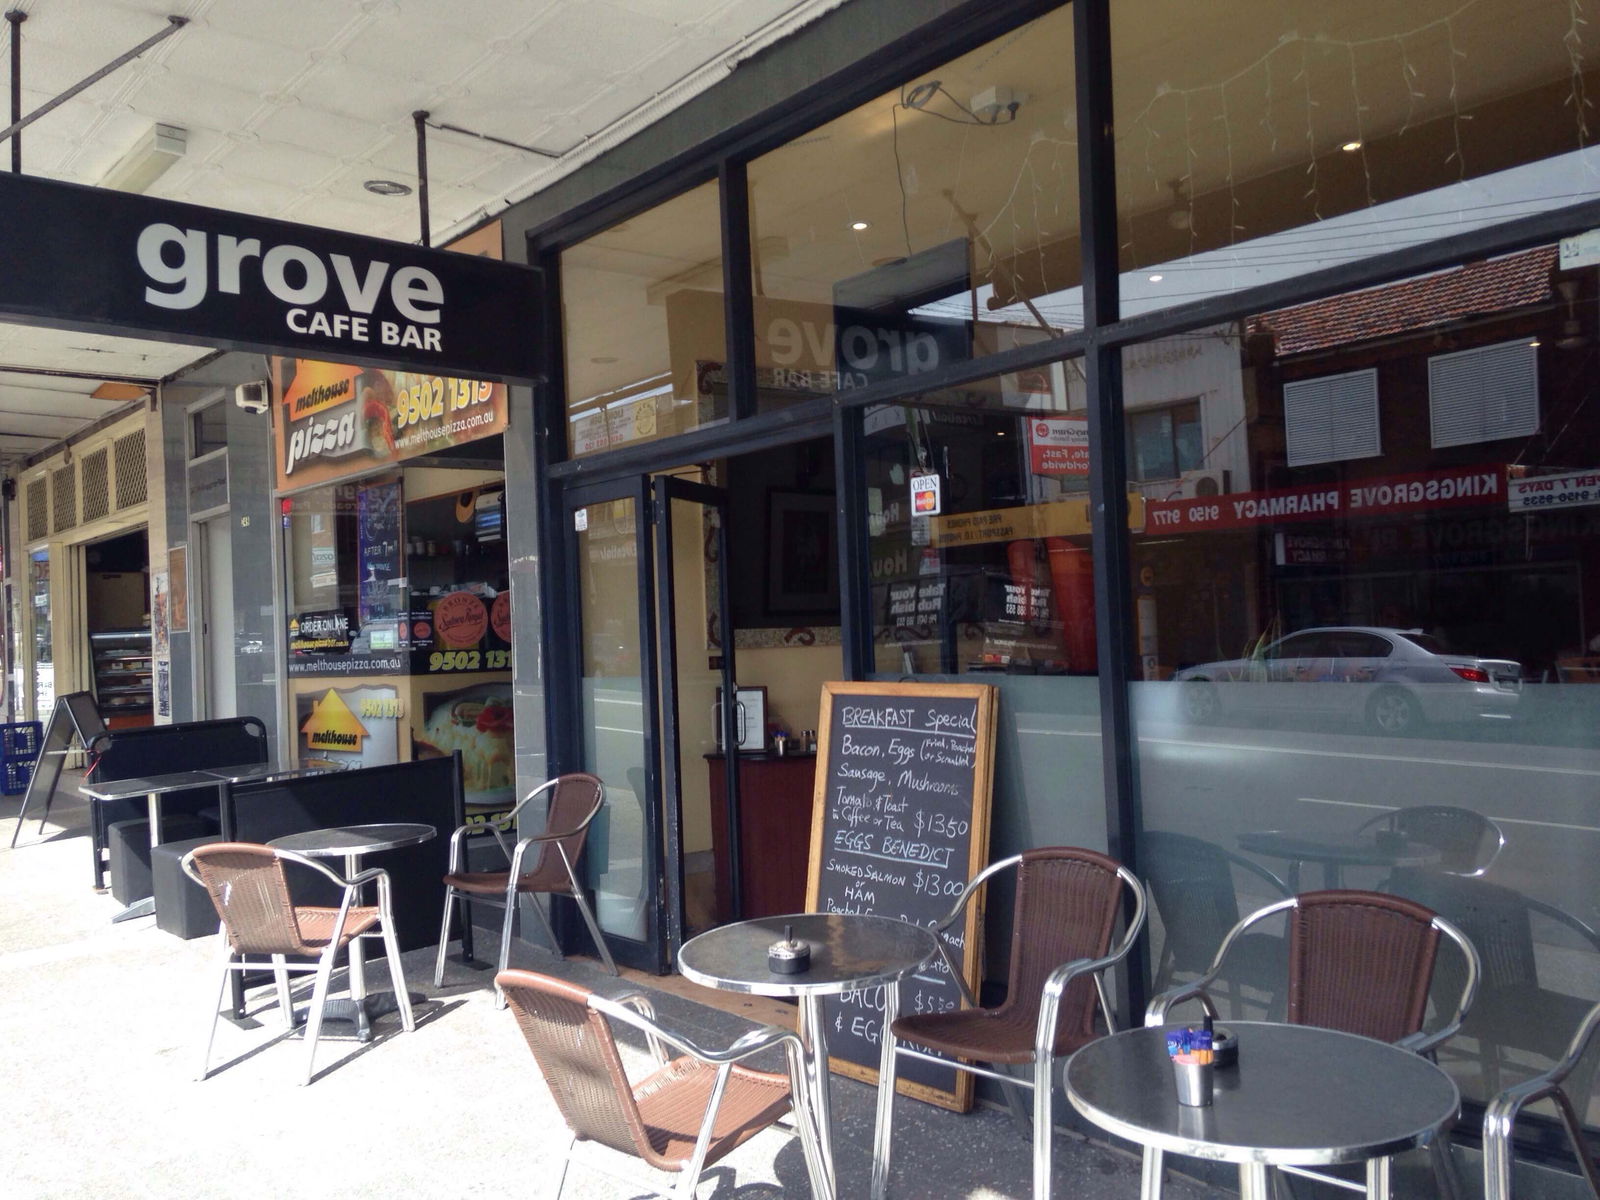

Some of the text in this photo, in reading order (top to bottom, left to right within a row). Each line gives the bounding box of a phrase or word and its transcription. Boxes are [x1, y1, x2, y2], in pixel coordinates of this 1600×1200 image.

[136, 222, 445, 324] grove
[285, 307, 442, 352] CAFE BAR
[295, 378, 350, 413] melthouse
[397, 376, 444, 428] 9502
[394, 409, 494, 449] www.melthousepizza.com.au
[285, 411, 356, 475] pizza
[912, 477, 937, 491] OPEN
[289, 655, 401, 674] www.melthousepizza.com.au
[429, 649, 512, 672] 9502 131
[841, 704, 977, 735] BREAKFAST Special
[312, 731, 358, 747] melthouse
[888, 738, 915, 765] Eggs
[897, 770, 959, 796] Mushrooms
[837, 785, 872, 808] Tomato
[883, 794, 909, 813] Toast
[841, 806, 871, 828] Coffee
[873, 817, 883, 826] or
[884, 815, 904, 832] Tea
[834, 830, 955, 869] EGGS BENEDICT
[855, 880, 866, 888] or
[864, 864, 907, 886] SALMON
[844, 886, 875, 904] HAM
